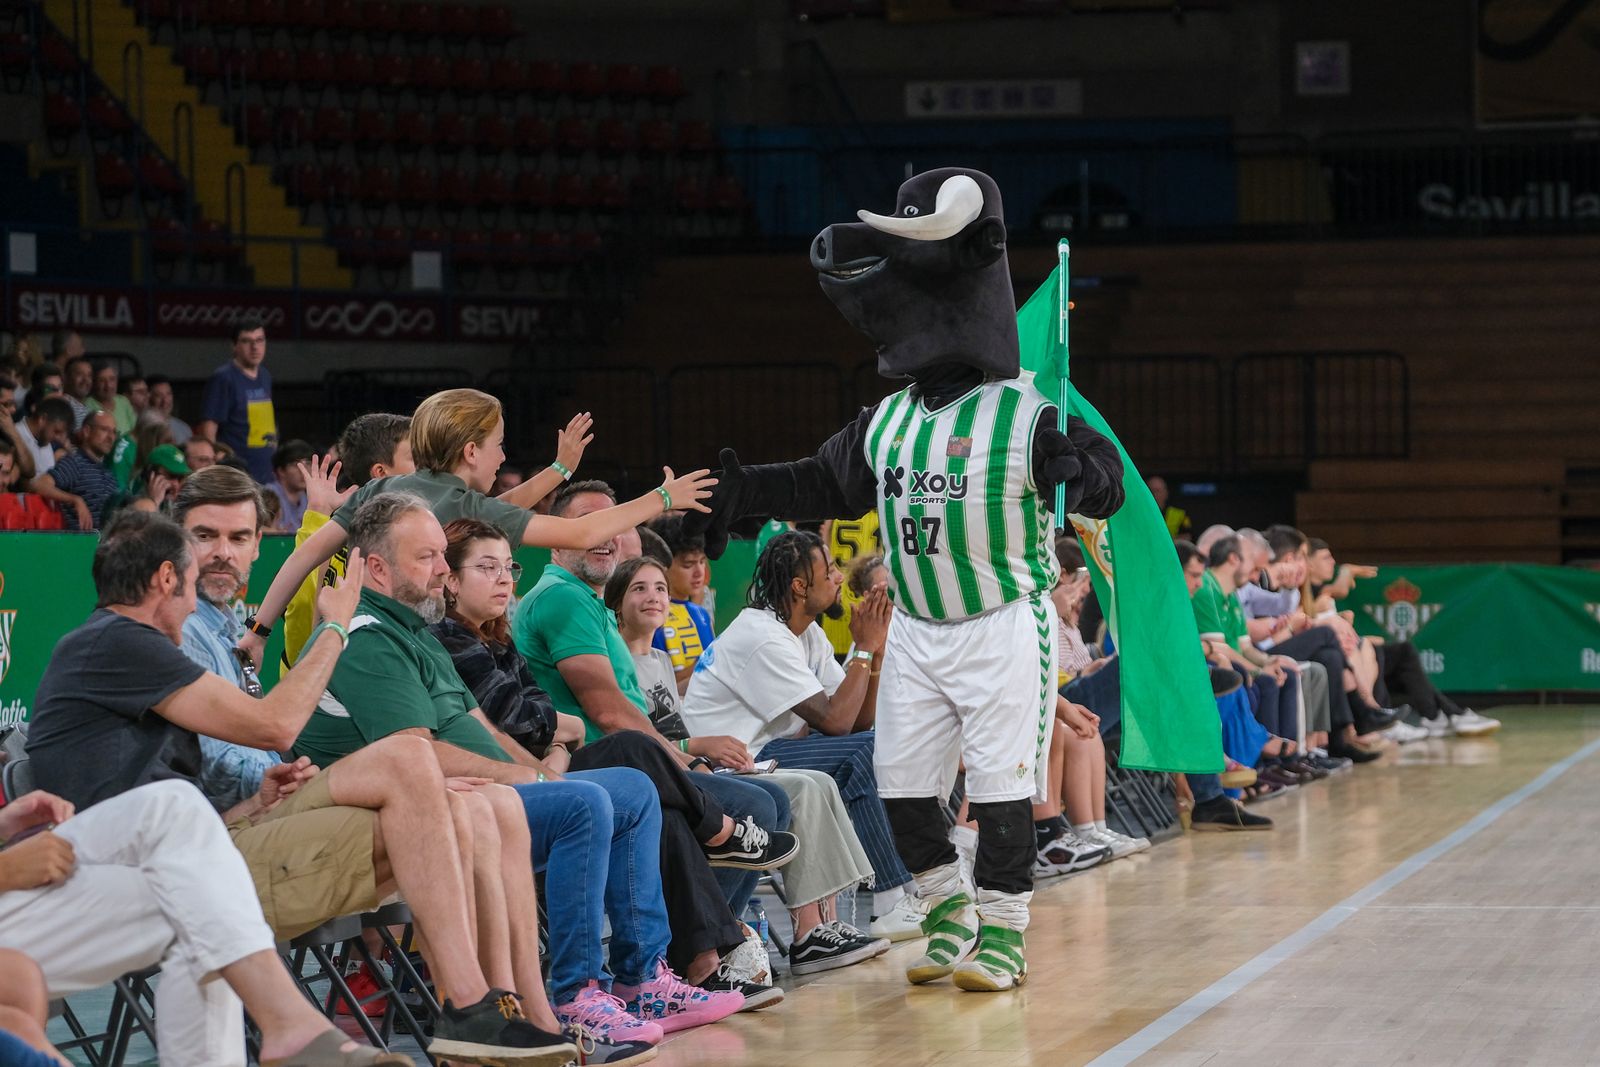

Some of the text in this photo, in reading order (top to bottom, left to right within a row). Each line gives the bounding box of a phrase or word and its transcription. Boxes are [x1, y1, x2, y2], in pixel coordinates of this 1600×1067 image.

[19, 292, 133, 327] SEVILLA
[910, 471, 968, 499] Xoy
[901, 517, 941, 555] 87
